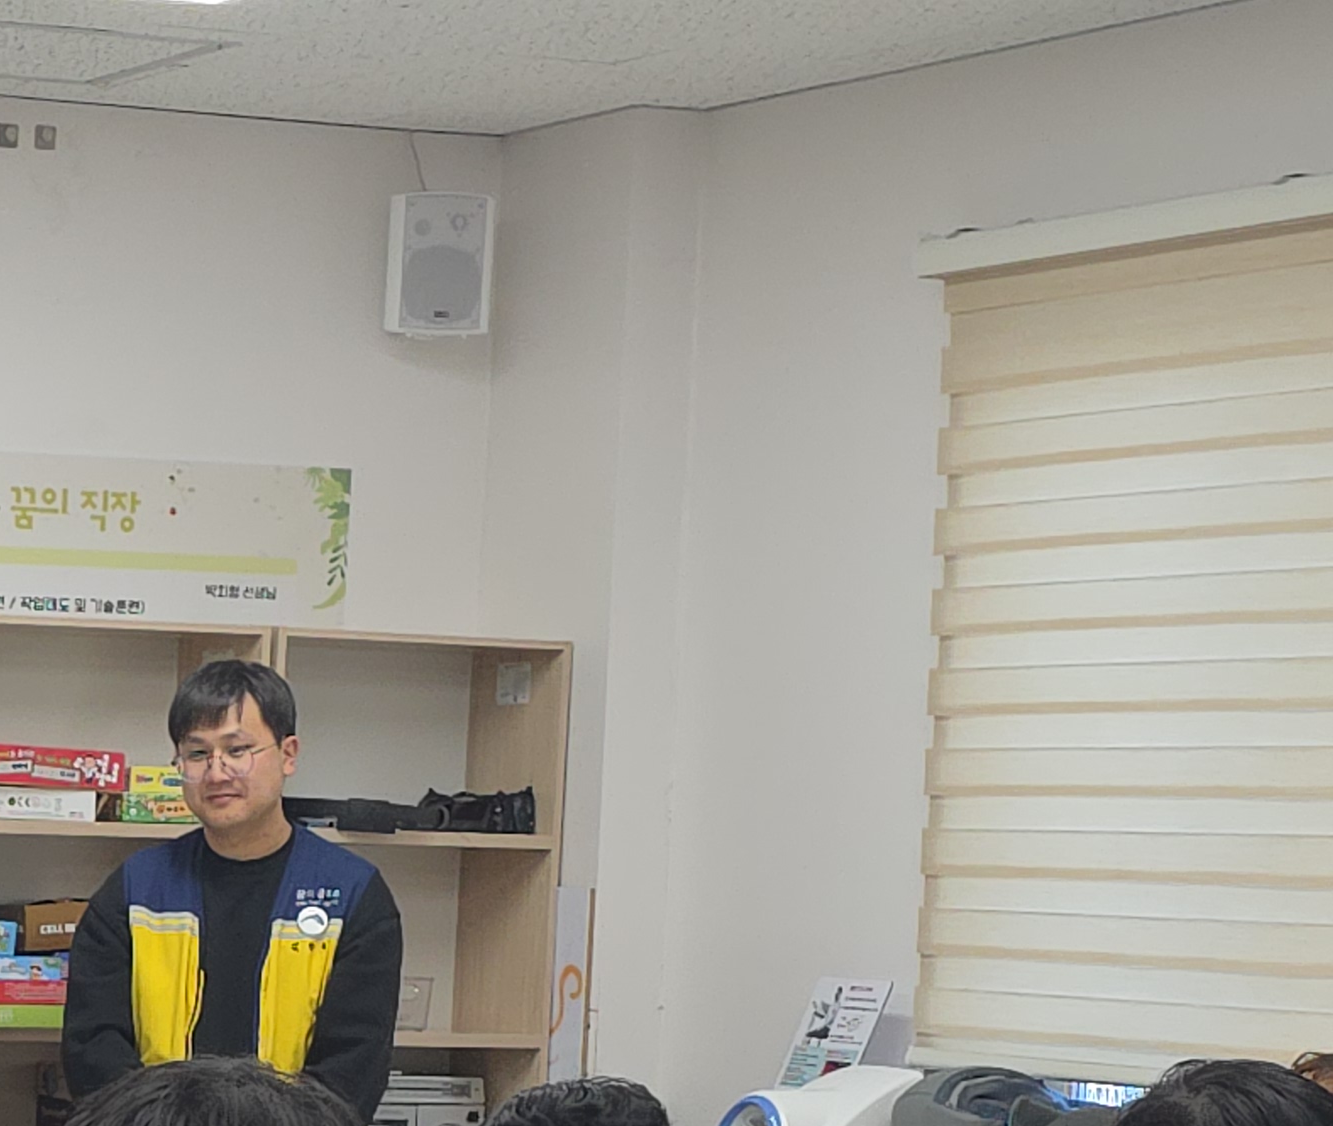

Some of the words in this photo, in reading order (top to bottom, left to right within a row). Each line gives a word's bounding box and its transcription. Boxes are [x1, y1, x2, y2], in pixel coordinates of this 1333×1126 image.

[9, 485, 69, 530] 꿈의
[79, 489, 141, 534] 직장
[74, 597, 87, 614] 및
